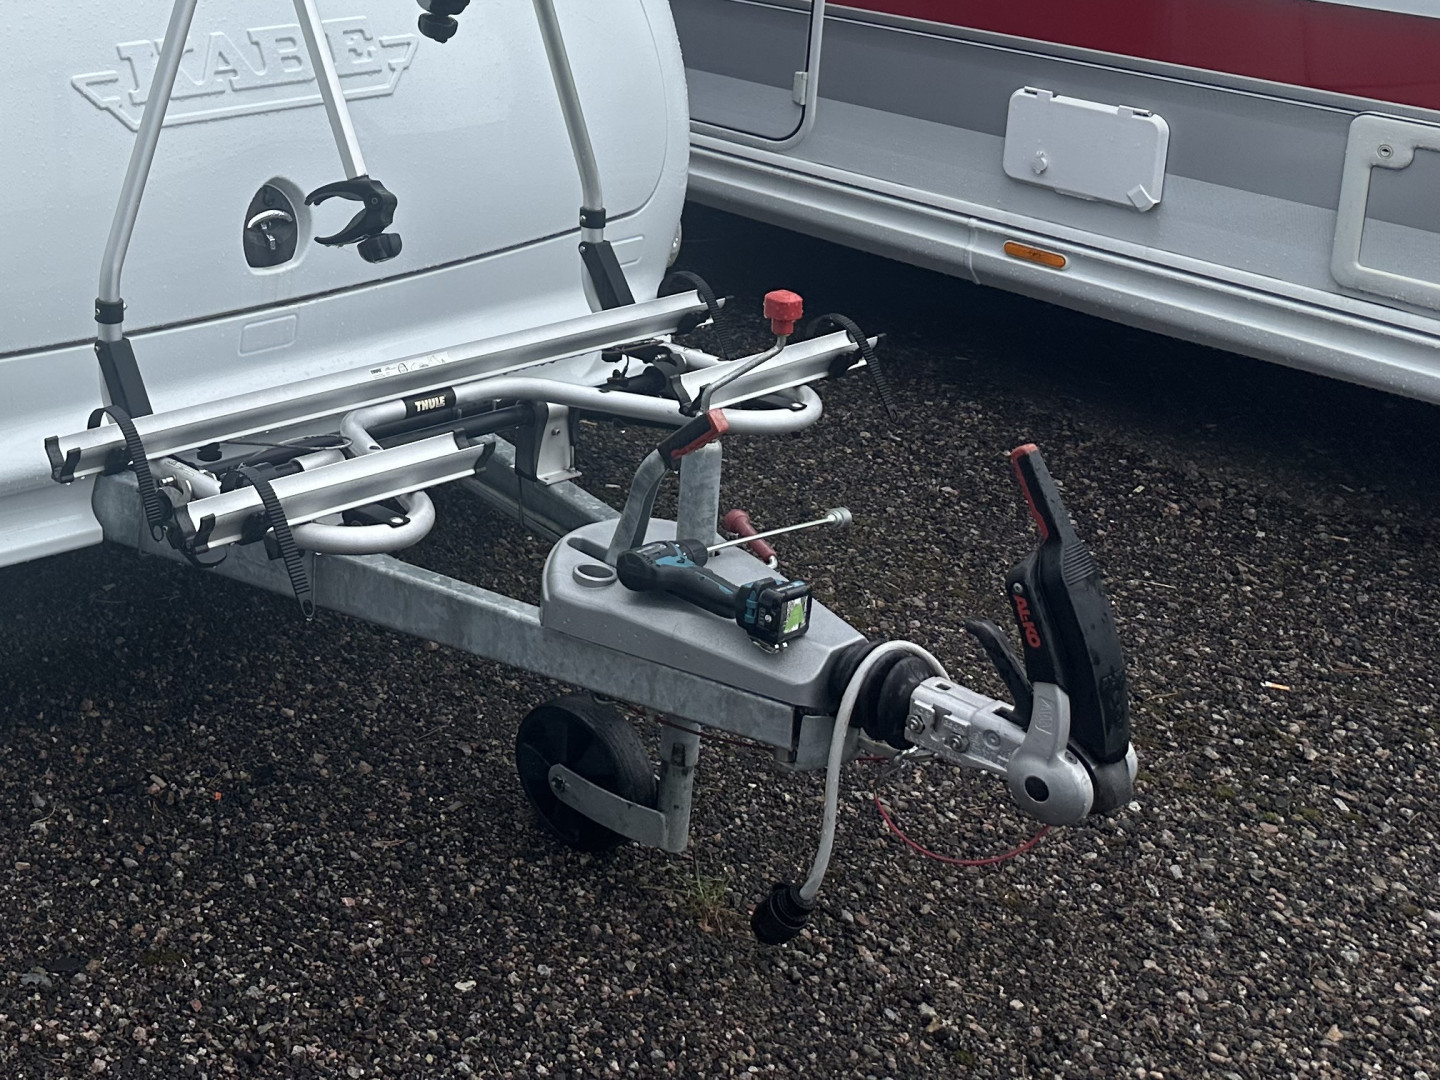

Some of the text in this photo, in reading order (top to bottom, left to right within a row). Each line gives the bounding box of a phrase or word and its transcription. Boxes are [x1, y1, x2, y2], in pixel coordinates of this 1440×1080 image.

[116, 16, 383, 107] KABE
[414, 395, 446, 412] THULE
[1013, 594, 1041, 648] AL-KO
